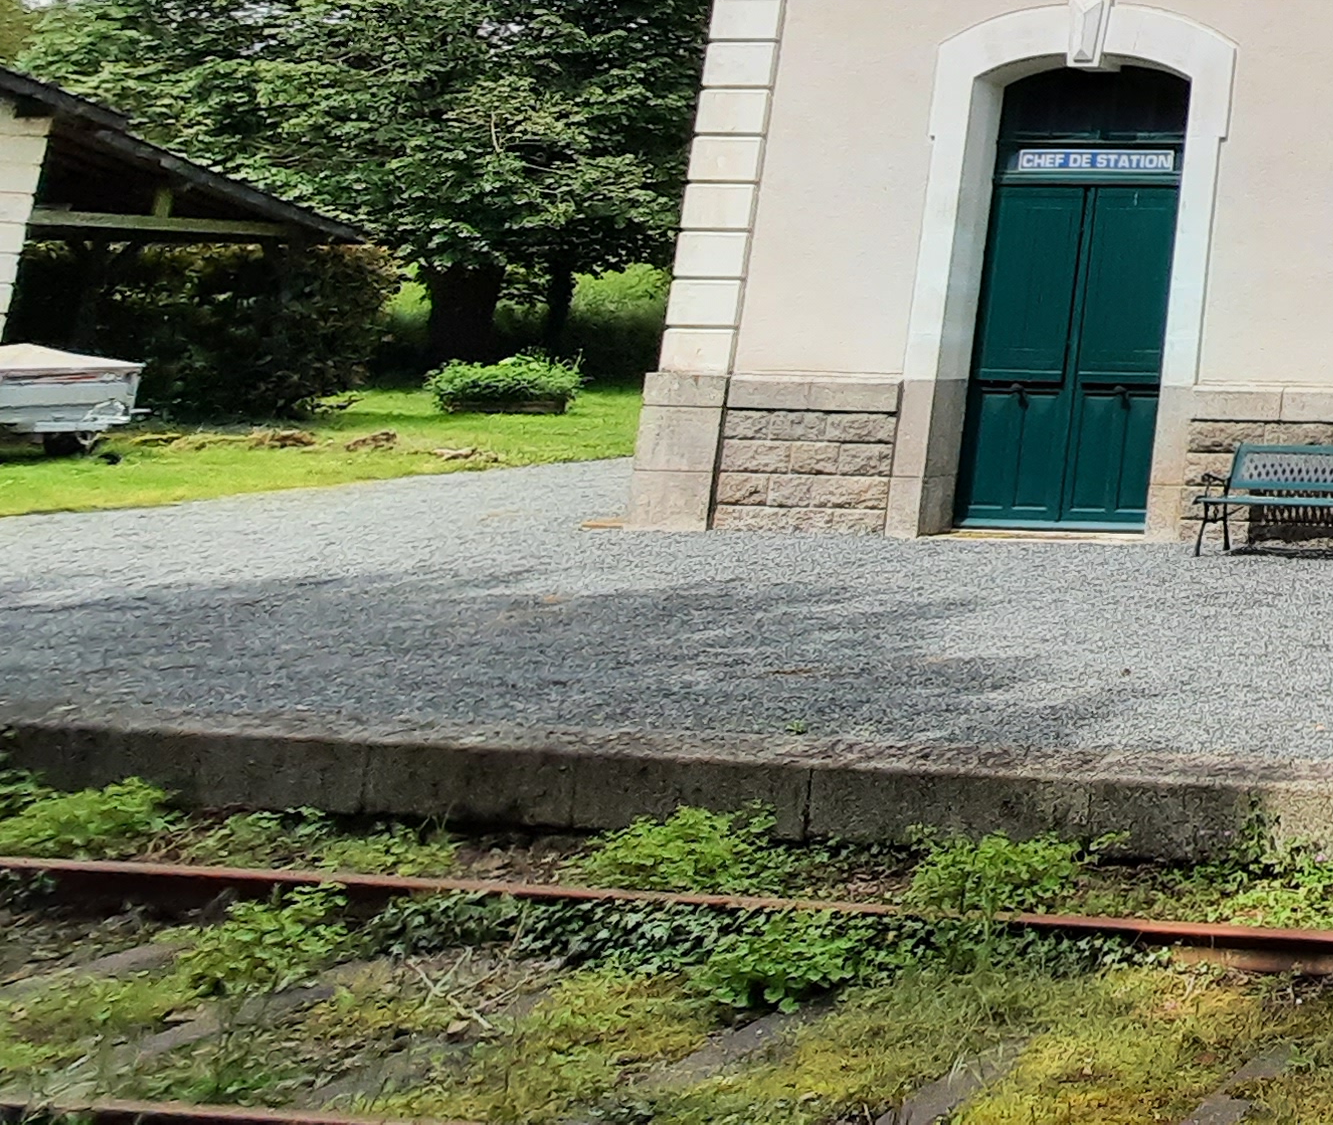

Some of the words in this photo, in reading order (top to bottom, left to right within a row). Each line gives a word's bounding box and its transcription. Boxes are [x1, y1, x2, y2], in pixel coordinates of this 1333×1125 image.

[1022, 153, 1064, 168] CHEF
[1068, 154, 1092, 168] DE
[1096, 154, 1171, 169] STATION
